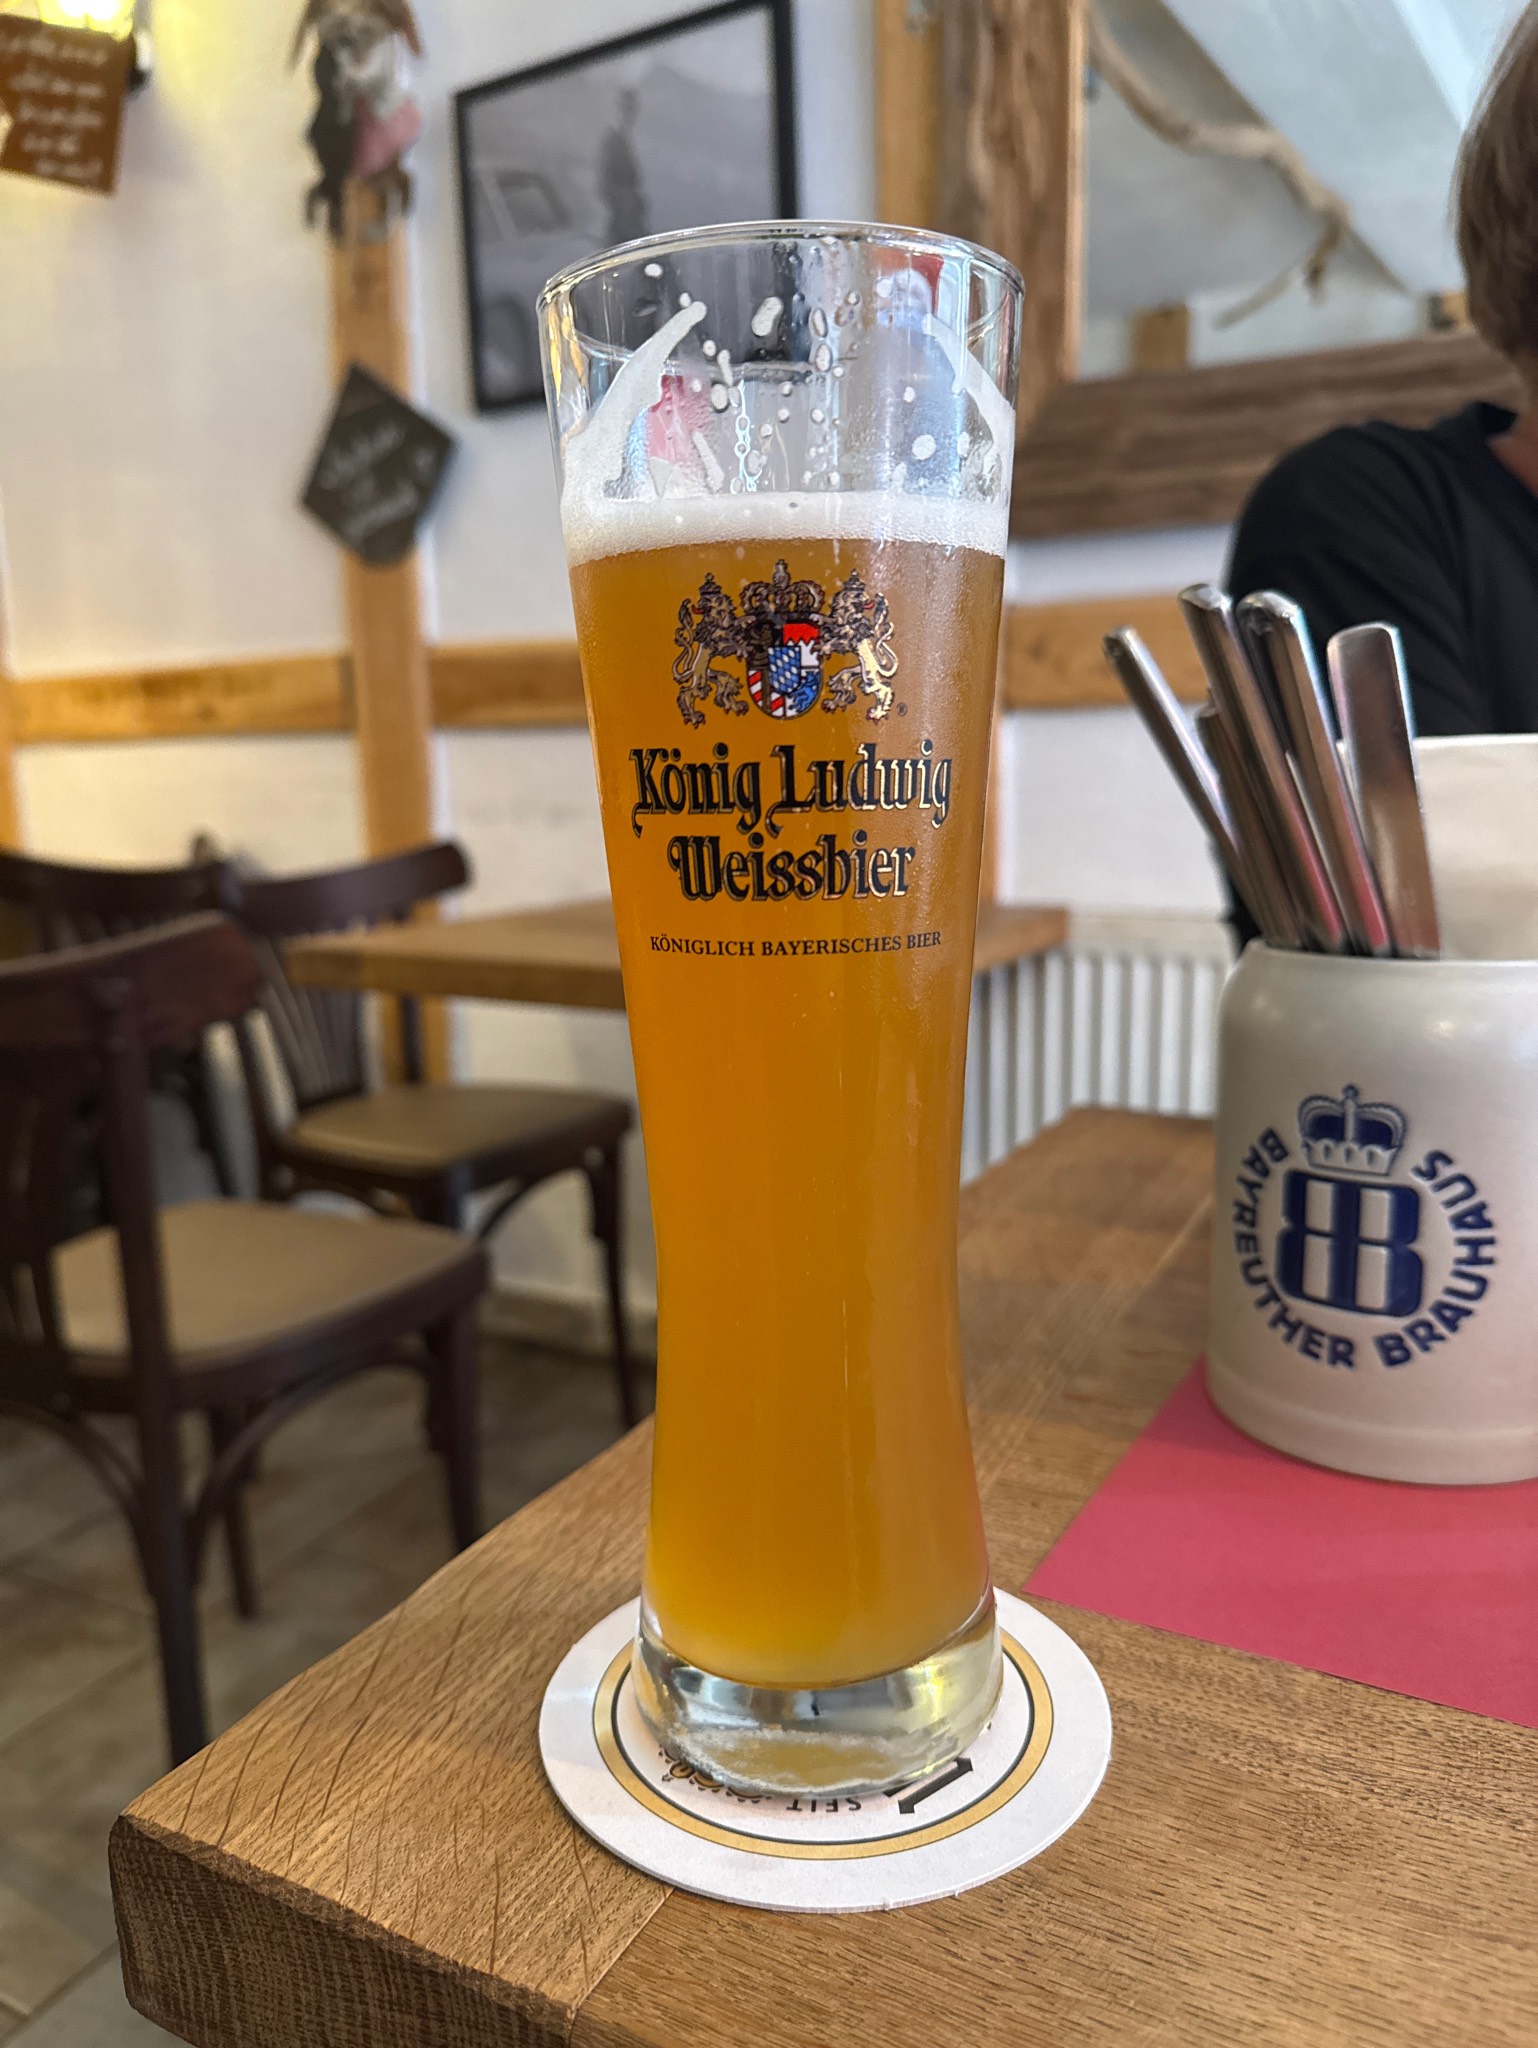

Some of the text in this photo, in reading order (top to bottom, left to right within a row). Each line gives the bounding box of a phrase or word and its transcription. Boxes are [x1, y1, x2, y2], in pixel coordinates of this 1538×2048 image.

[629, 739, 952, 838] König Ludwig
[667, 829, 915, 901] Weissbier
[650, 931, 941, 957] KÖNIGLICH BAYERISCHES BIER
[1232, 1127, 1496, 1368] BAYREUTHER BRAUHAUS
